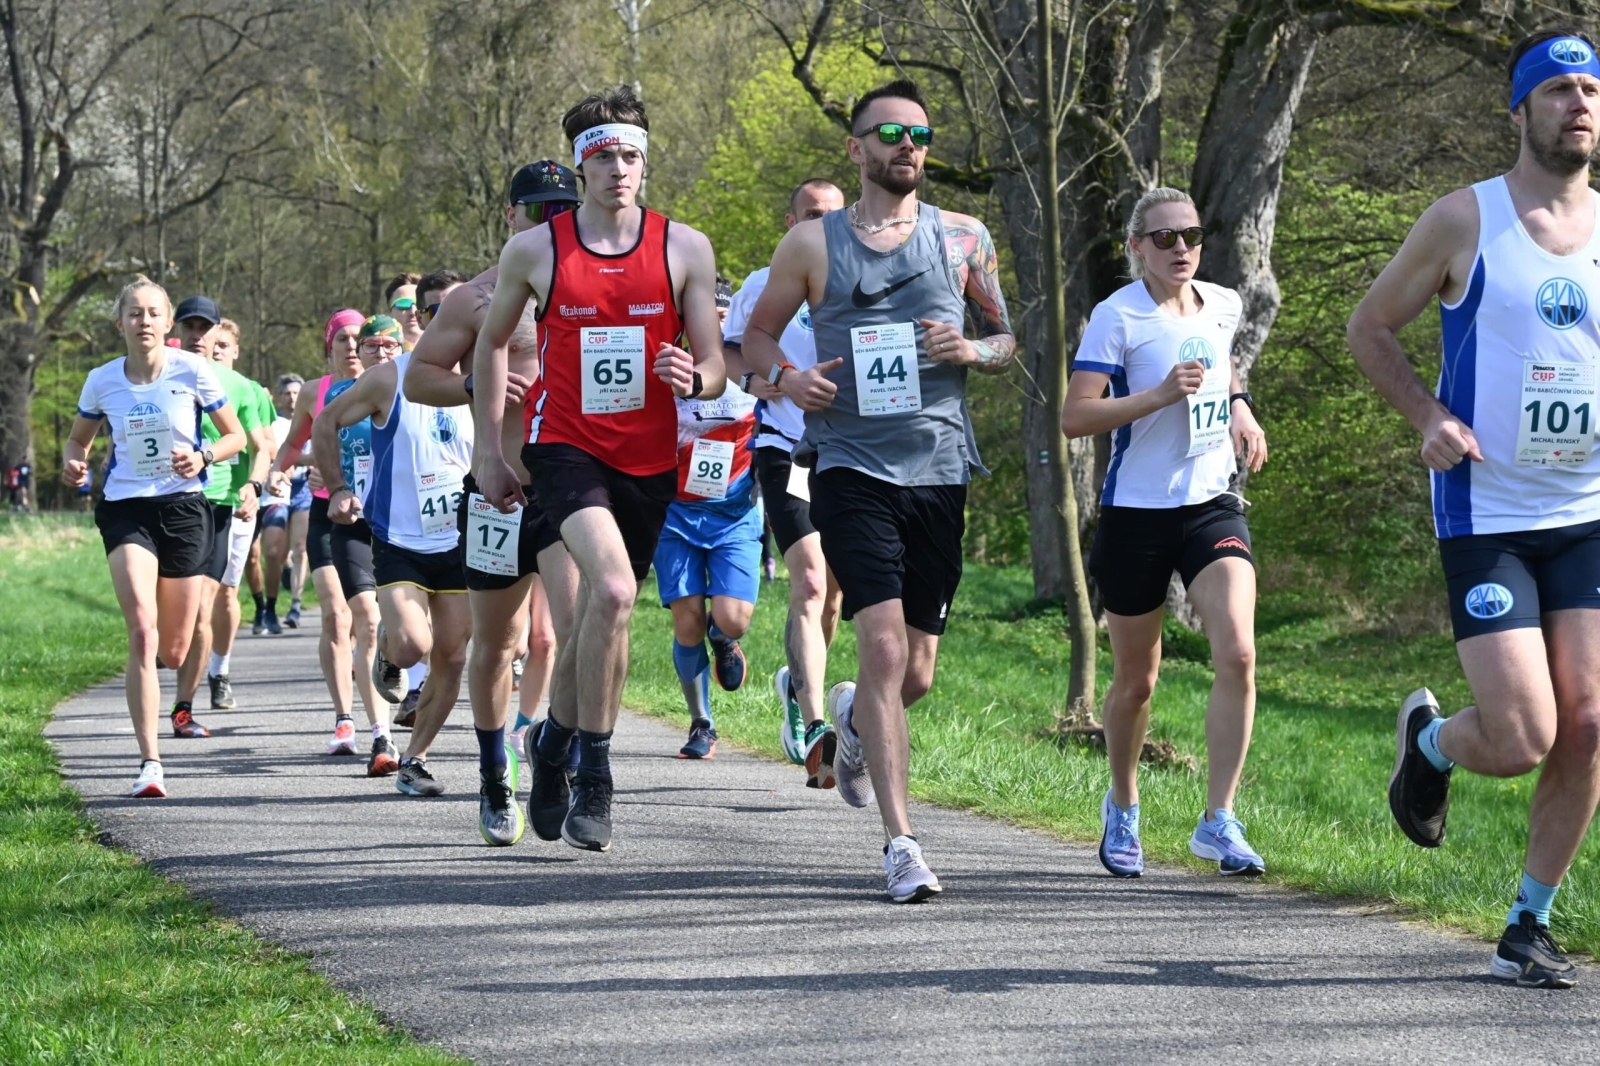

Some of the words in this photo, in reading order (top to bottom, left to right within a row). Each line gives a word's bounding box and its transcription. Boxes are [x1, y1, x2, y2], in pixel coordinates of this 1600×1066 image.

[585, 130, 604, 141] LES
[580, 136, 620, 154] MARATON
[628, 302, 665, 312] MARATON
[859, 335, 878, 344] CUP
[593, 358, 633, 386] 65
[866, 354, 908, 385] 44
[1532, 371, 1555, 381] CUP
[1572, 388, 1595, 396] ÚDOLÍM
[690, 402, 740, 412] GLADIATOR
[1192, 399, 1229, 430] 174
[1524, 400, 1590, 435] 101
[143, 437, 159, 458] 3
[1556, 437, 1580, 445] RENSKÝ
[697, 460, 723, 480] 98
[421, 477, 436, 485] CUP
[421, 491, 463, 517] 413
[474, 503, 491, 511] CUP
[478, 524, 510, 550] 17
